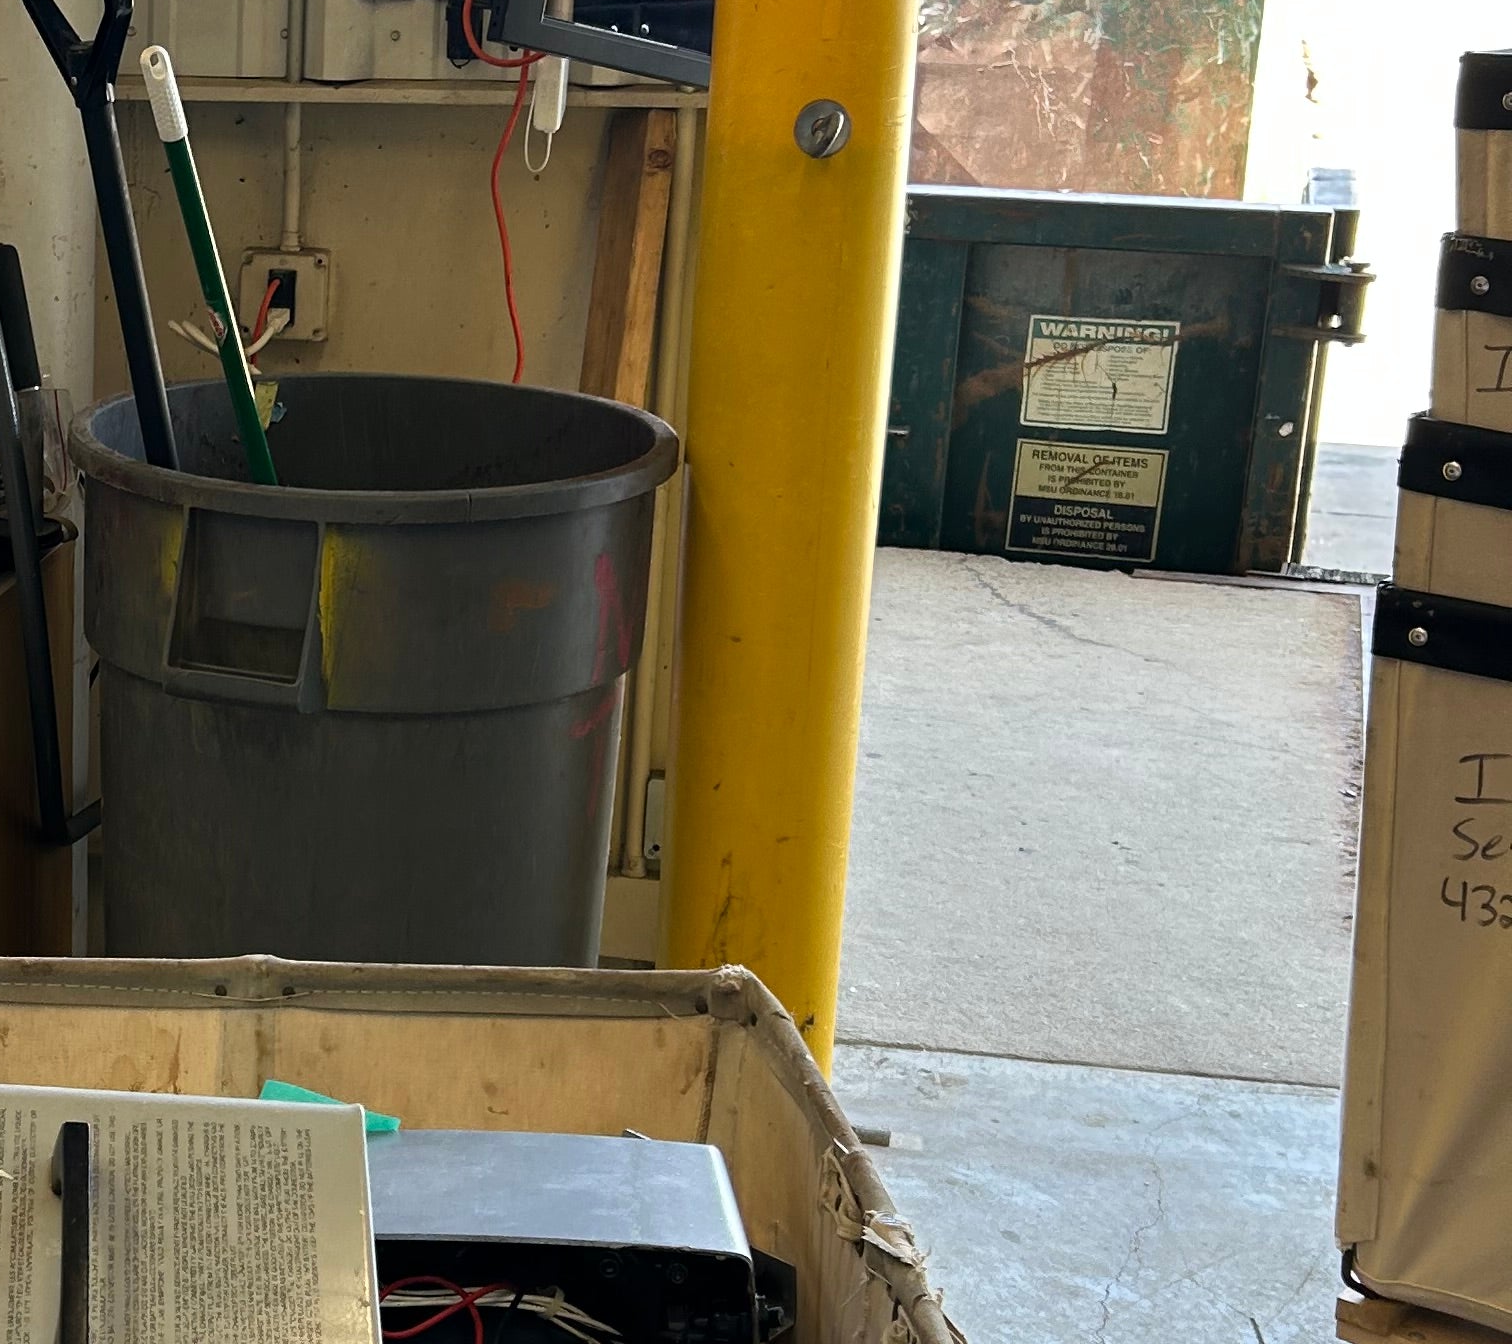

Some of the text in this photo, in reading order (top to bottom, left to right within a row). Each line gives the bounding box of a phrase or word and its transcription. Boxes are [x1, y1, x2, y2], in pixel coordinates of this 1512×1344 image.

[1040, 321, 1170, 342] WARNING!
[1032, 449, 1089, 464] REMOVAL
[1112, 456, 1149, 469] ITEMS
[1039, 463, 1065, 474] FROM
[1048, 475, 1056, 484] IS
[1113, 480, 1126, 489] BY
[1059, 486, 1111, 499] ORDINANCE
[1054, 505, 1114, 520] DISPOSAL
[1033, 516, 1102, 530] UNAUTHORIZED
